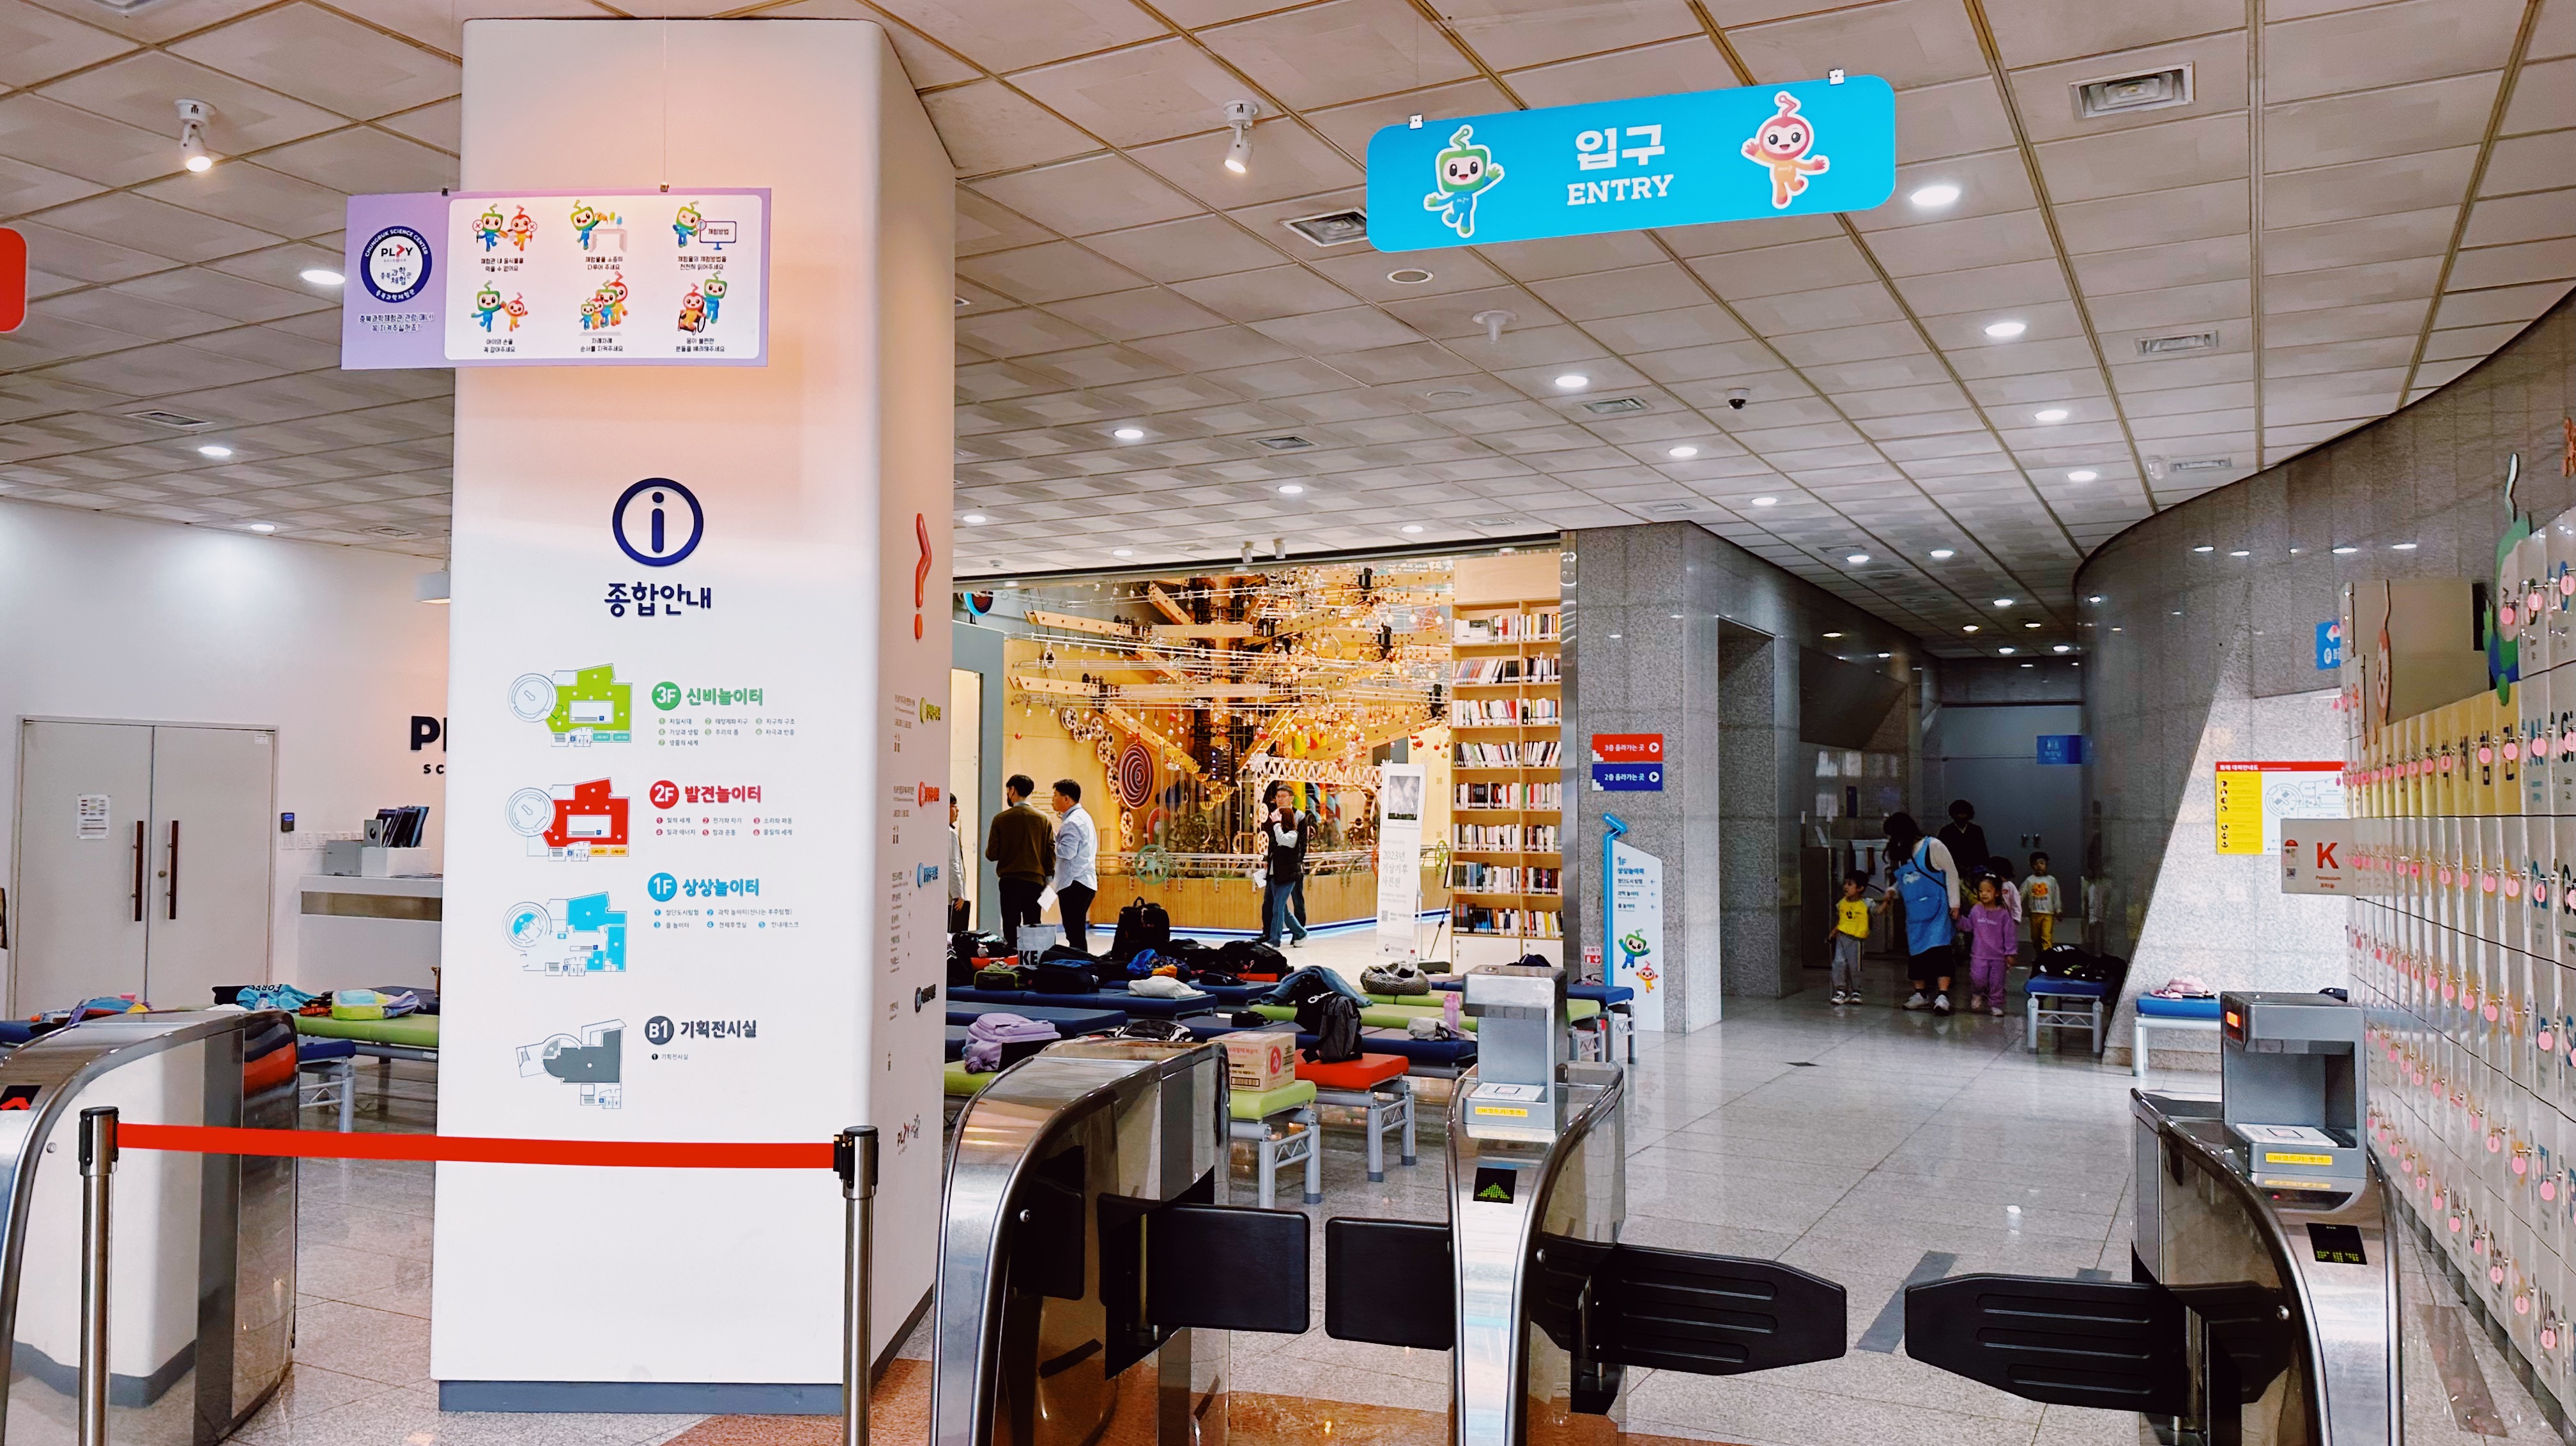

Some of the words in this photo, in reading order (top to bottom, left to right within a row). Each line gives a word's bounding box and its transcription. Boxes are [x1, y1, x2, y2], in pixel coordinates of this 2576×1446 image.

[1575, 124, 1666, 171] 입구
[1567, 173, 1674, 207] ENTRY
[365, 231, 389, 257] CHUNGBUK
[413, 235, 429, 255] CENTER
[360, 314, 403, 323] 충북과학체험관
[604, 580, 712, 618] 종합안내
[656, 686, 677, 705] 3F
[686, 687, 763, 707] 신비놀이터
[654, 785, 675, 803] 2F
[684, 785, 762, 803] 발견놀이터
[1383, 850, 1405, 861] 2023년
[1617, 856, 1627, 865] 1F
[2317, 842, 2339, 869] K
[1382, 863, 1408, 875] 기상기후
[653, 877, 672, 895] 1F
[682, 878, 760, 896] 상상놀이터
[1381, 875, 1400, 888] 사진전
[648, 1020, 668, 1038] B1
[680, 1020, 756, 1039] 기획전시실
